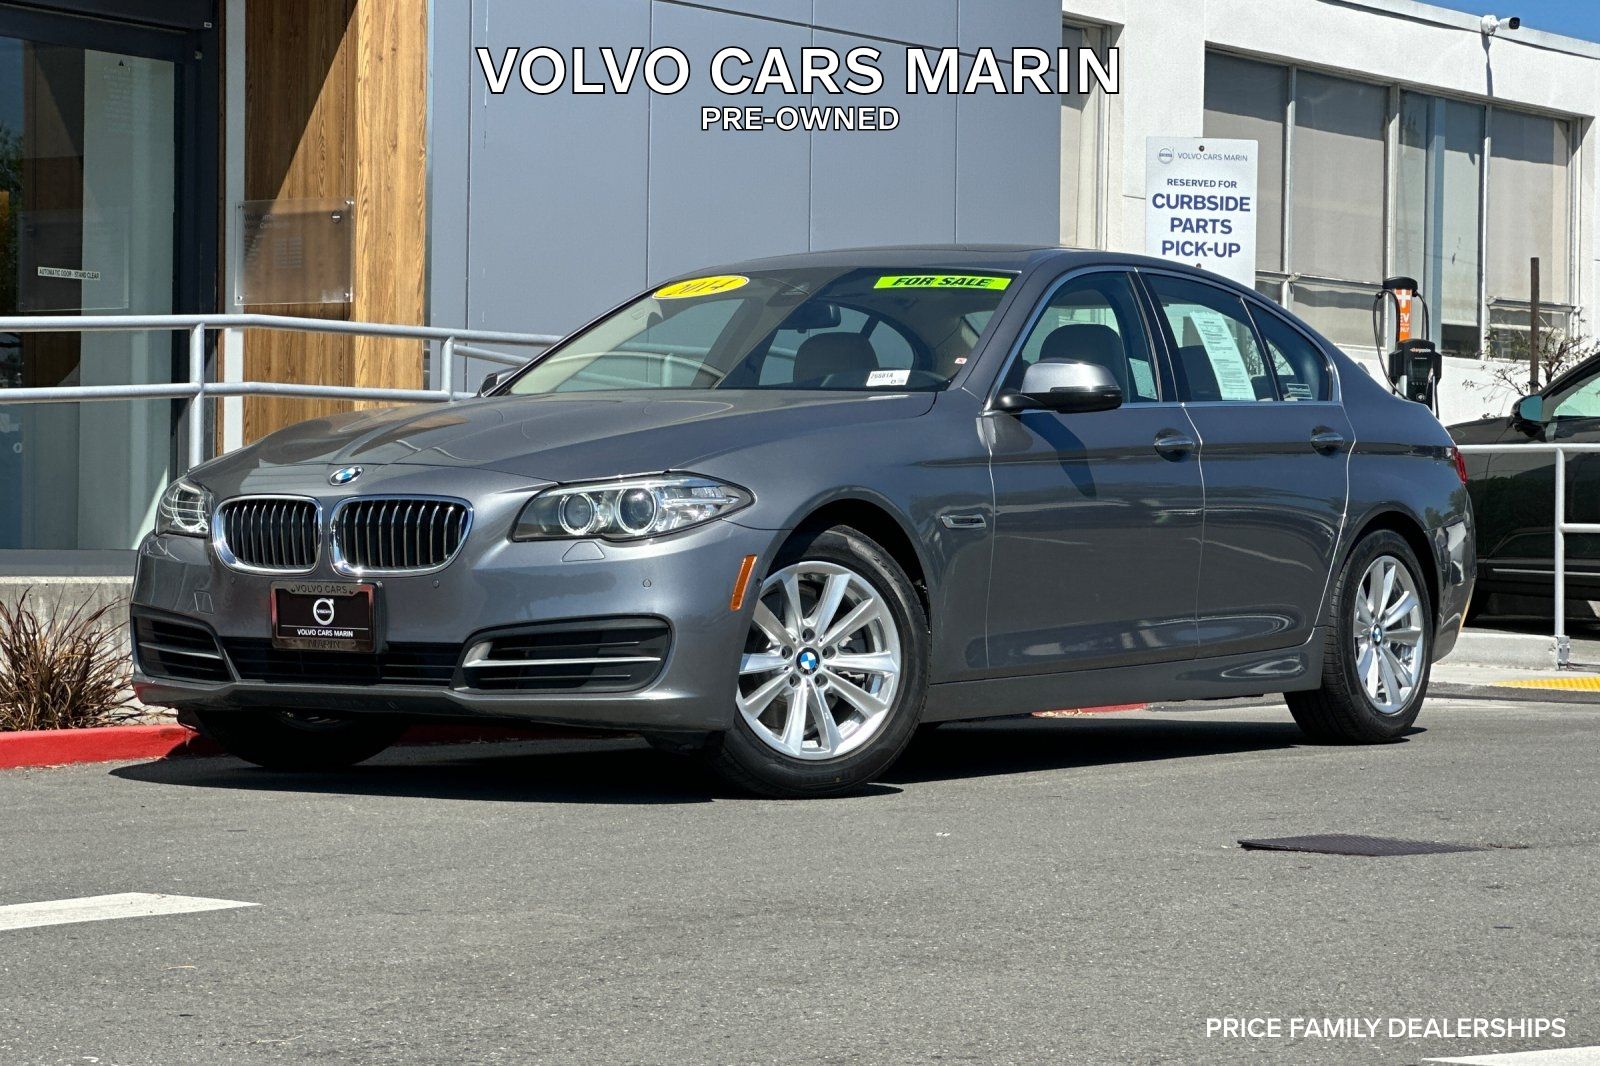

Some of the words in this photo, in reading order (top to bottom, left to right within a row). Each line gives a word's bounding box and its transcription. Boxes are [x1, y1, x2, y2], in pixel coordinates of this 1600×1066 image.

[1177, 152, 1202, 160] VOLVO
[1203, 153, 1222, 161] CARS
[1224, 154, 1248, 162] MARIN
[1166, 178, 1217, 188] RESERVED
[1218, 180, 1237, 188] FOR
[1152, 193, 1250, 212] CURBSIDE
[1170, 217, 1233, 235] PARTS
[1161, 240, 1241, 258] PICK-UP
[39, 268, 60, 276] AUTOMATIC
[61, 269, 72, 277] DOOR
[892, 277, 937, 286] FOR
[938, 277, 993, 287] SALE
[295, 585, 322, 593] VOLVO
[324, 585, 348, 594] CARS
[333, 630, 354, 638] MARIN
[308, 639, 340, 649] MARIN
